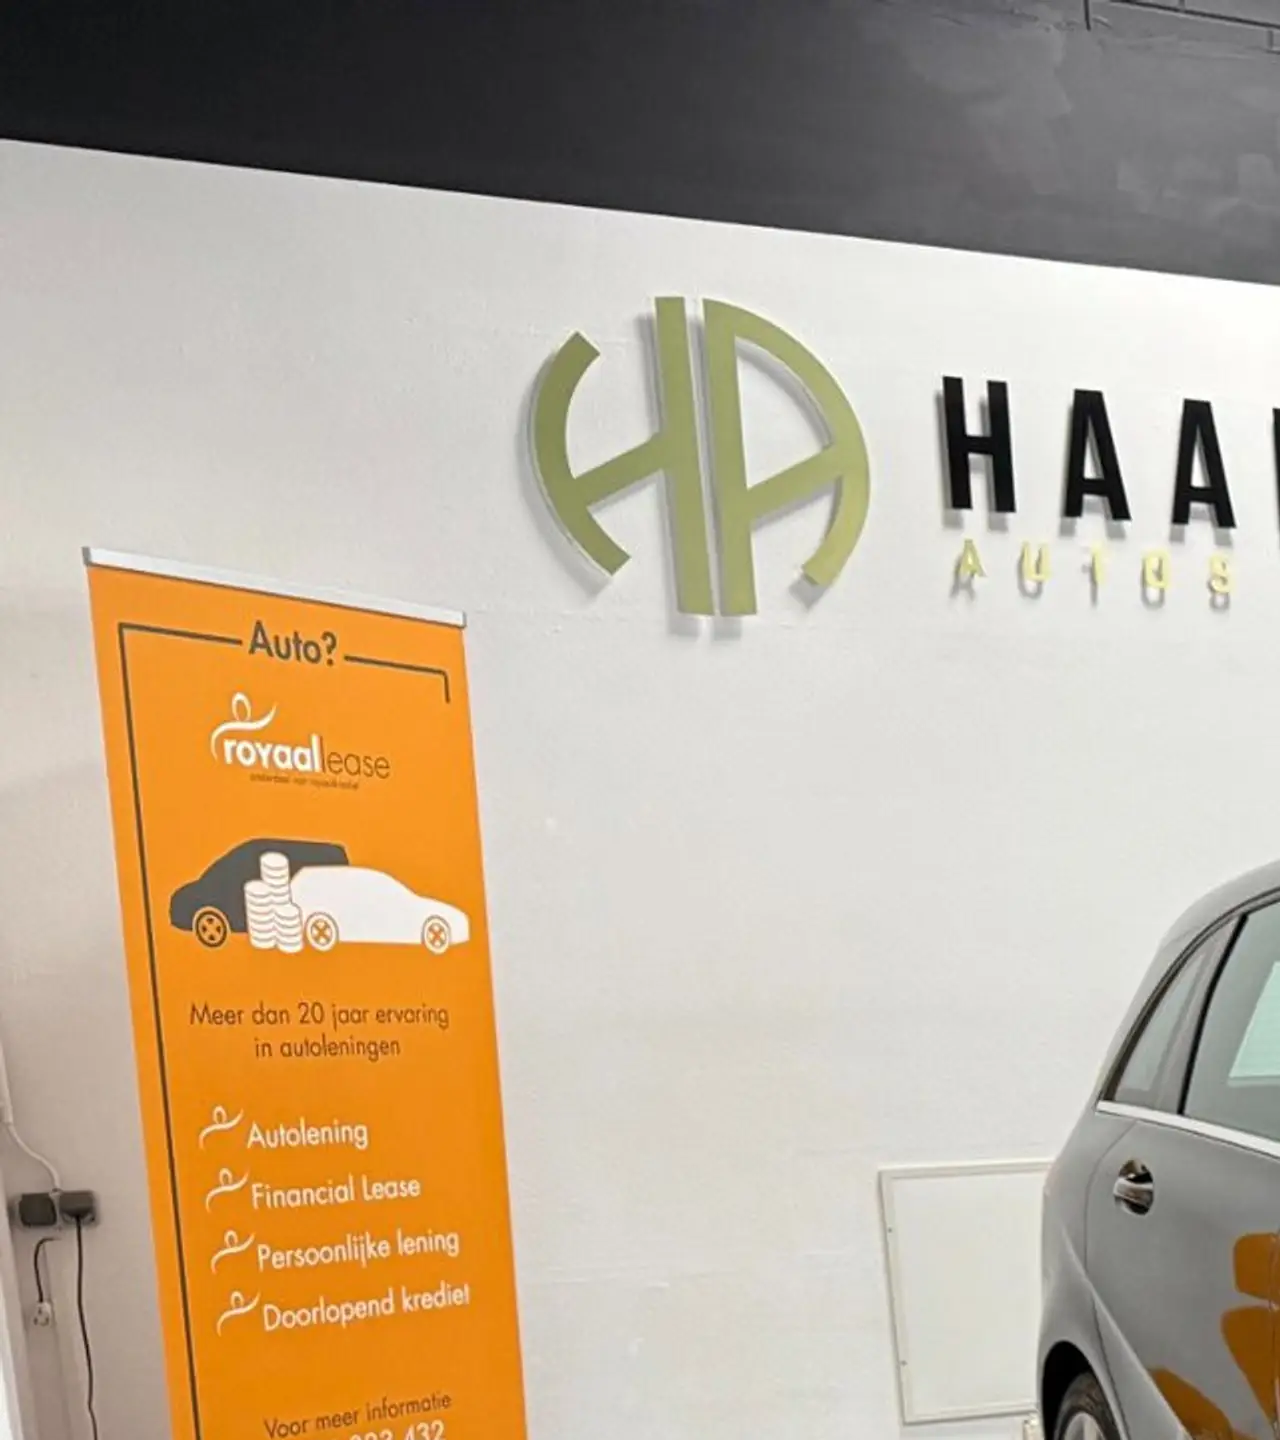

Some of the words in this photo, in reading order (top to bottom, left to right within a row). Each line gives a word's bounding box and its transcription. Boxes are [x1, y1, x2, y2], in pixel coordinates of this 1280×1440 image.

[248, 620, 338, 666] Auto?
[190, 1002, 244, 1026] Meer
[252, 1002, 289, 1024] dan
[298, 1002, 324, 1024] 20
[332, 1004, 369, 1031] jaar
[376, 1003, 448, 1029] ervaring
[255, 1037, 272, 1058] in
[280, 1034, 401, 1063] autoleningen
[247, 1117, 368, 1149] Autolening
[251, 1174, 354, 1209] Financial
[362, 1175, 420, 1201] Lease
[257, 1234, 390, 1272] Persoonlijke
[397, 1229, 459, 1257] lening
[263, 1289, 394, 1331] Doorlopend
[402, 1280, 469, 1311] krediet
[264, 1417, 308, 1439] Voor
[316, 1409, 358, 1431] meer
[366, 1392, 452, 1420] informatie
